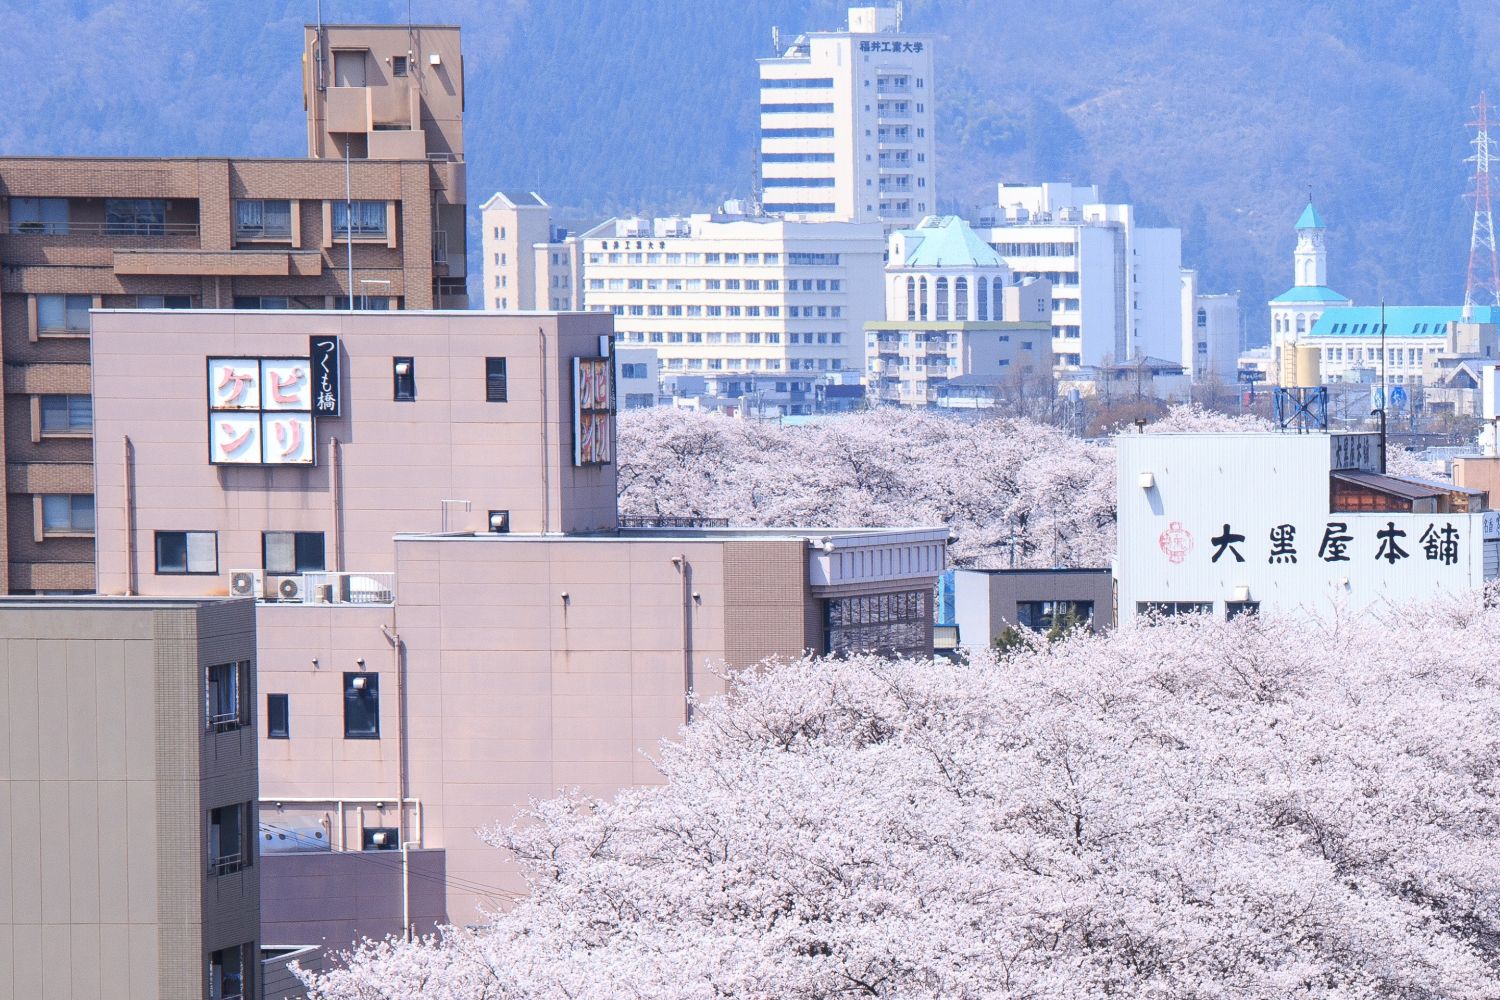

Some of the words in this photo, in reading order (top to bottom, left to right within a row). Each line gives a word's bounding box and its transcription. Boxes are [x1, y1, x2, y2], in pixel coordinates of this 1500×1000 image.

[859, 40, 923, 53] 福井工業大学
[316, 341, 336, 411] つくも橋
